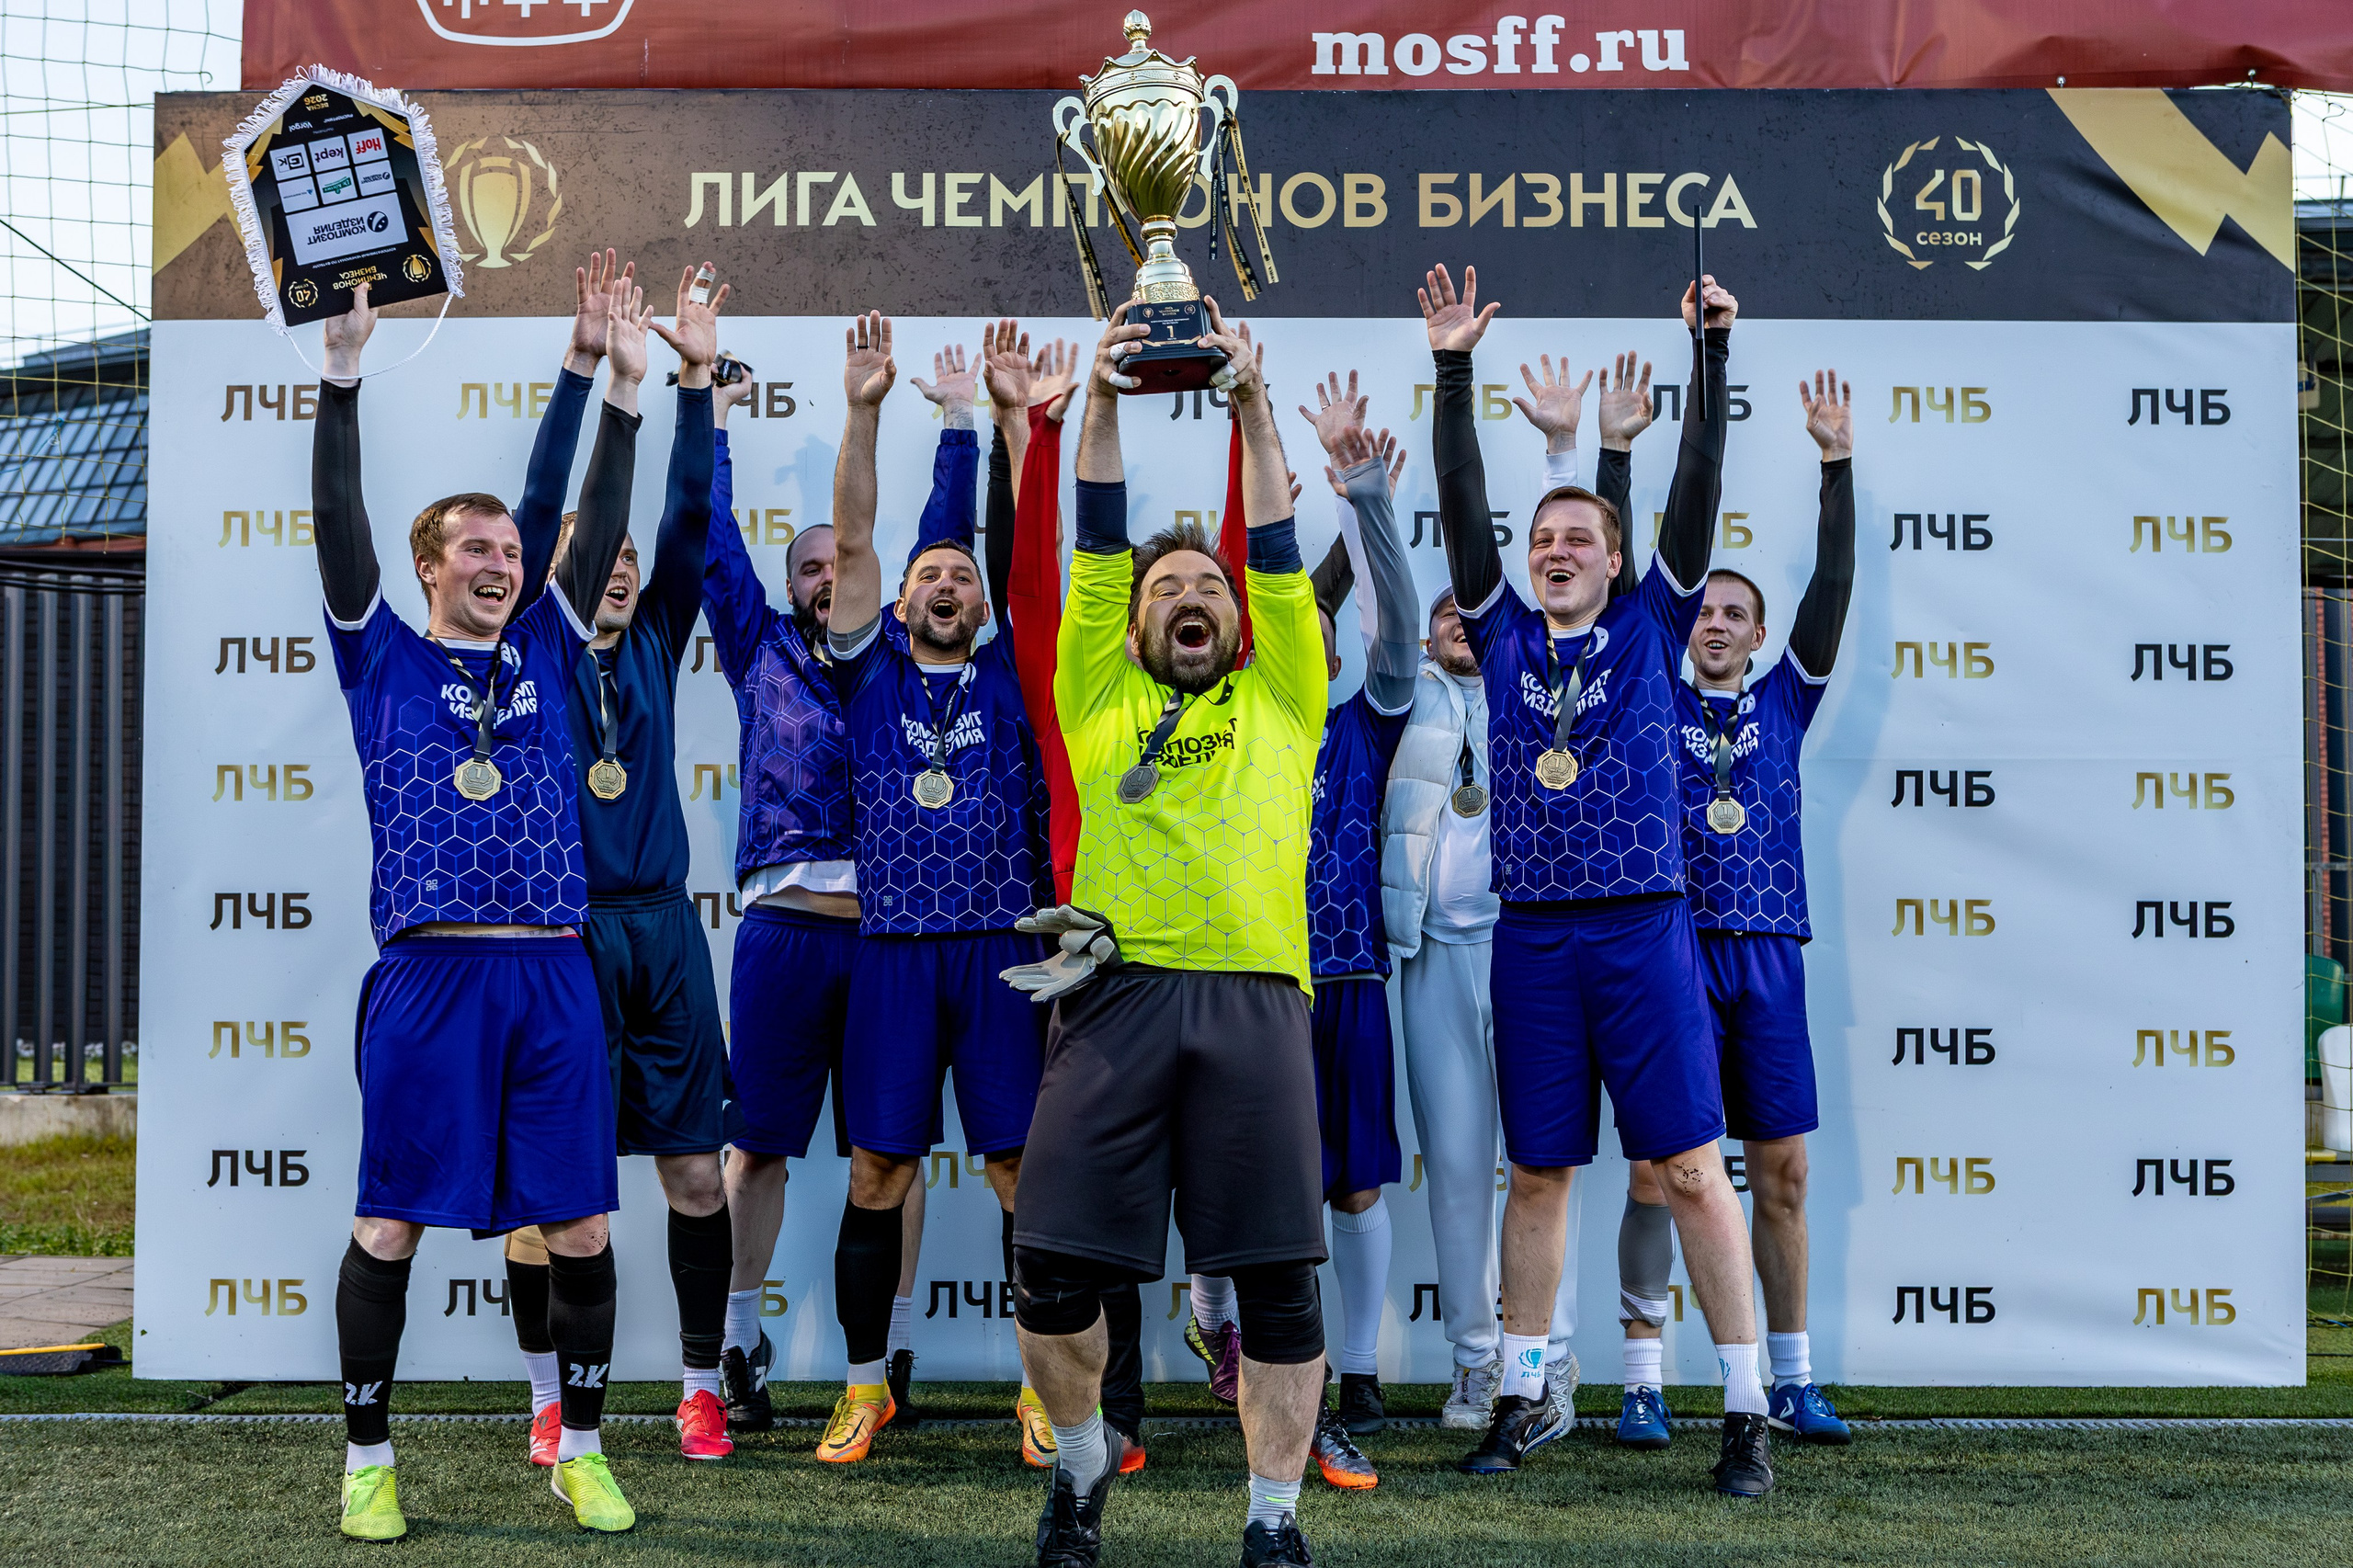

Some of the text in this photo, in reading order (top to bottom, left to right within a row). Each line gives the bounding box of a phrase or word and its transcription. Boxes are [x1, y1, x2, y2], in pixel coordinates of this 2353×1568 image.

[1312, 16, 1689, 75] mosff.ru
[303, 94, 328, 106] 2026
[306, 102, 329, 111] ВЕСНА
[313, 144, 345, 164] kept
[684, 172, 1757, 228] ЛИГА ЧЕМПОНОВ БИЗНЕСА
[1915, 169, 1982, 222] 40
[306, 224, 366, 245] КОМПОЗИТ
[313, 216, 364, 235] ИЗДЕЛИЯ
[1915, 229, 1983, 246] сезон
[339, 266, 377, 280] БИЗНЕСА
[221, 385, 319, 422] ЛЧБ
[734, 382, 796, 418] ЧБ
[1409, 384, 1513, 421] ЛБ
[1652, 384, 1753, 421] ЛБ
[1889, 386, 1991, 423] ЛЧБ
[2127, 389, 2231, 426] ЛЧБ
[218, 510, 315, 548] ЛЧБ
[733, 509, 795, 545] ЧБ
[1409, 511, 1513, 549] ЛБ
[1890, 513, 1993, 551] ЛЧБ
[2130, 516, 2233, 553] ЛЧБ
[215, 637, 315, 675] ЛЧБ
[1891, 642, 1995, 679] ЛЧБ
[2131, 643, 2234, 682] ЛЧБ
[212, 765, 313, 801] ЛЧБ
[1891, 770, 1995, 808] ЛЧБ
[2132, 772, 2234, 810] ЛЧБ
[210, 892, 312, 931] ЛЧБ
[1892, 899, 1995, 937] ЛЧБ
[2131, 901, 2234, 938] ЛЧБ
[209, 1021, 311, 1059] ЛЧБ
[1892, 1028, 1995, 1066] ЛЧБ
[2132, 1029, 2235, 1068] ЛЧБ
[207, 1150, 310, 1187] ЛЧБ
[926, 1152, 993, 1189] ЛЧ
[1892, 1157, 1995, 1195] ЛЧБ
[2131, 1159, 2234, 1197] ЛЧБ
[205, 1278, 308, 1316] ЛЧБ
[443, 1278, 510, 1316] ЛЧ
[1893, 1286, 1995, 1324] ЛЧБ
[2132, 1288, 2236, 1325] ЛЧБ
